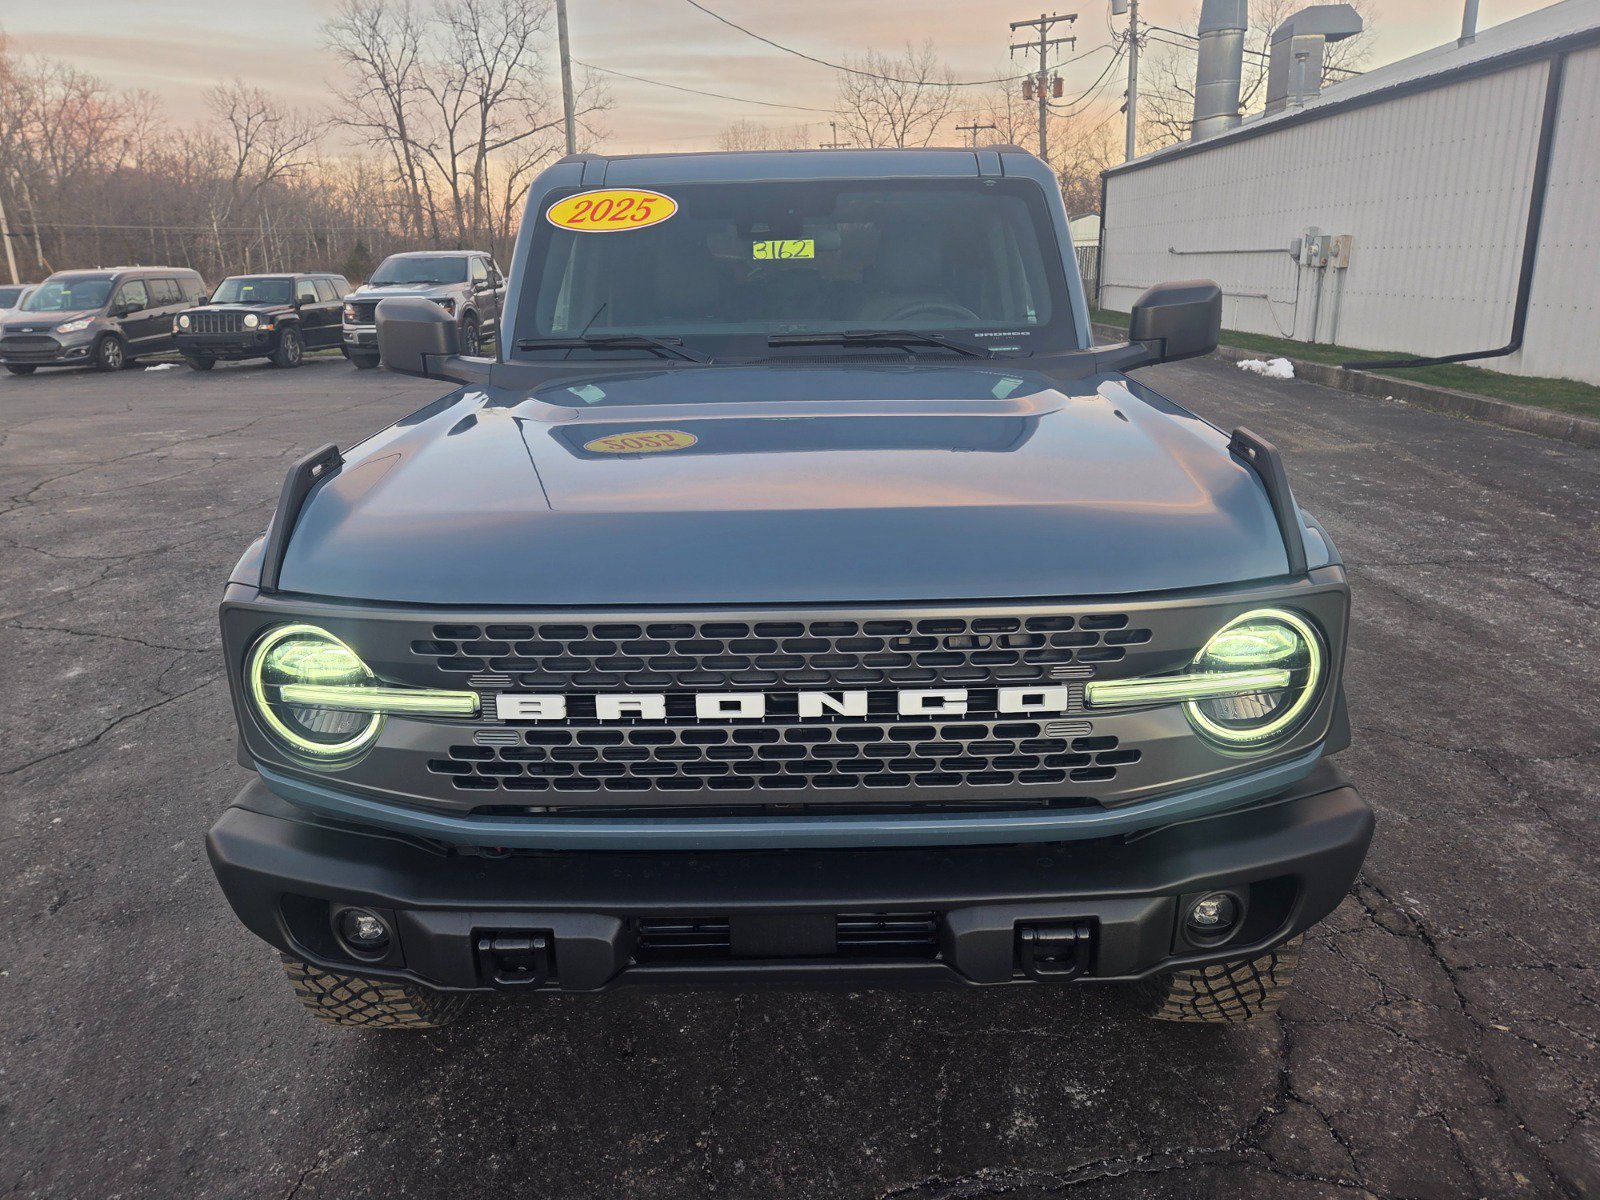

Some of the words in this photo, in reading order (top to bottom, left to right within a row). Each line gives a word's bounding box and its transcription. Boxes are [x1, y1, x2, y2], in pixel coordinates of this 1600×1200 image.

[567, 198, 658, 223] 2025
[753, 240, 809, 260] 3162
[495, 685, 1068, 720] BRONCO
